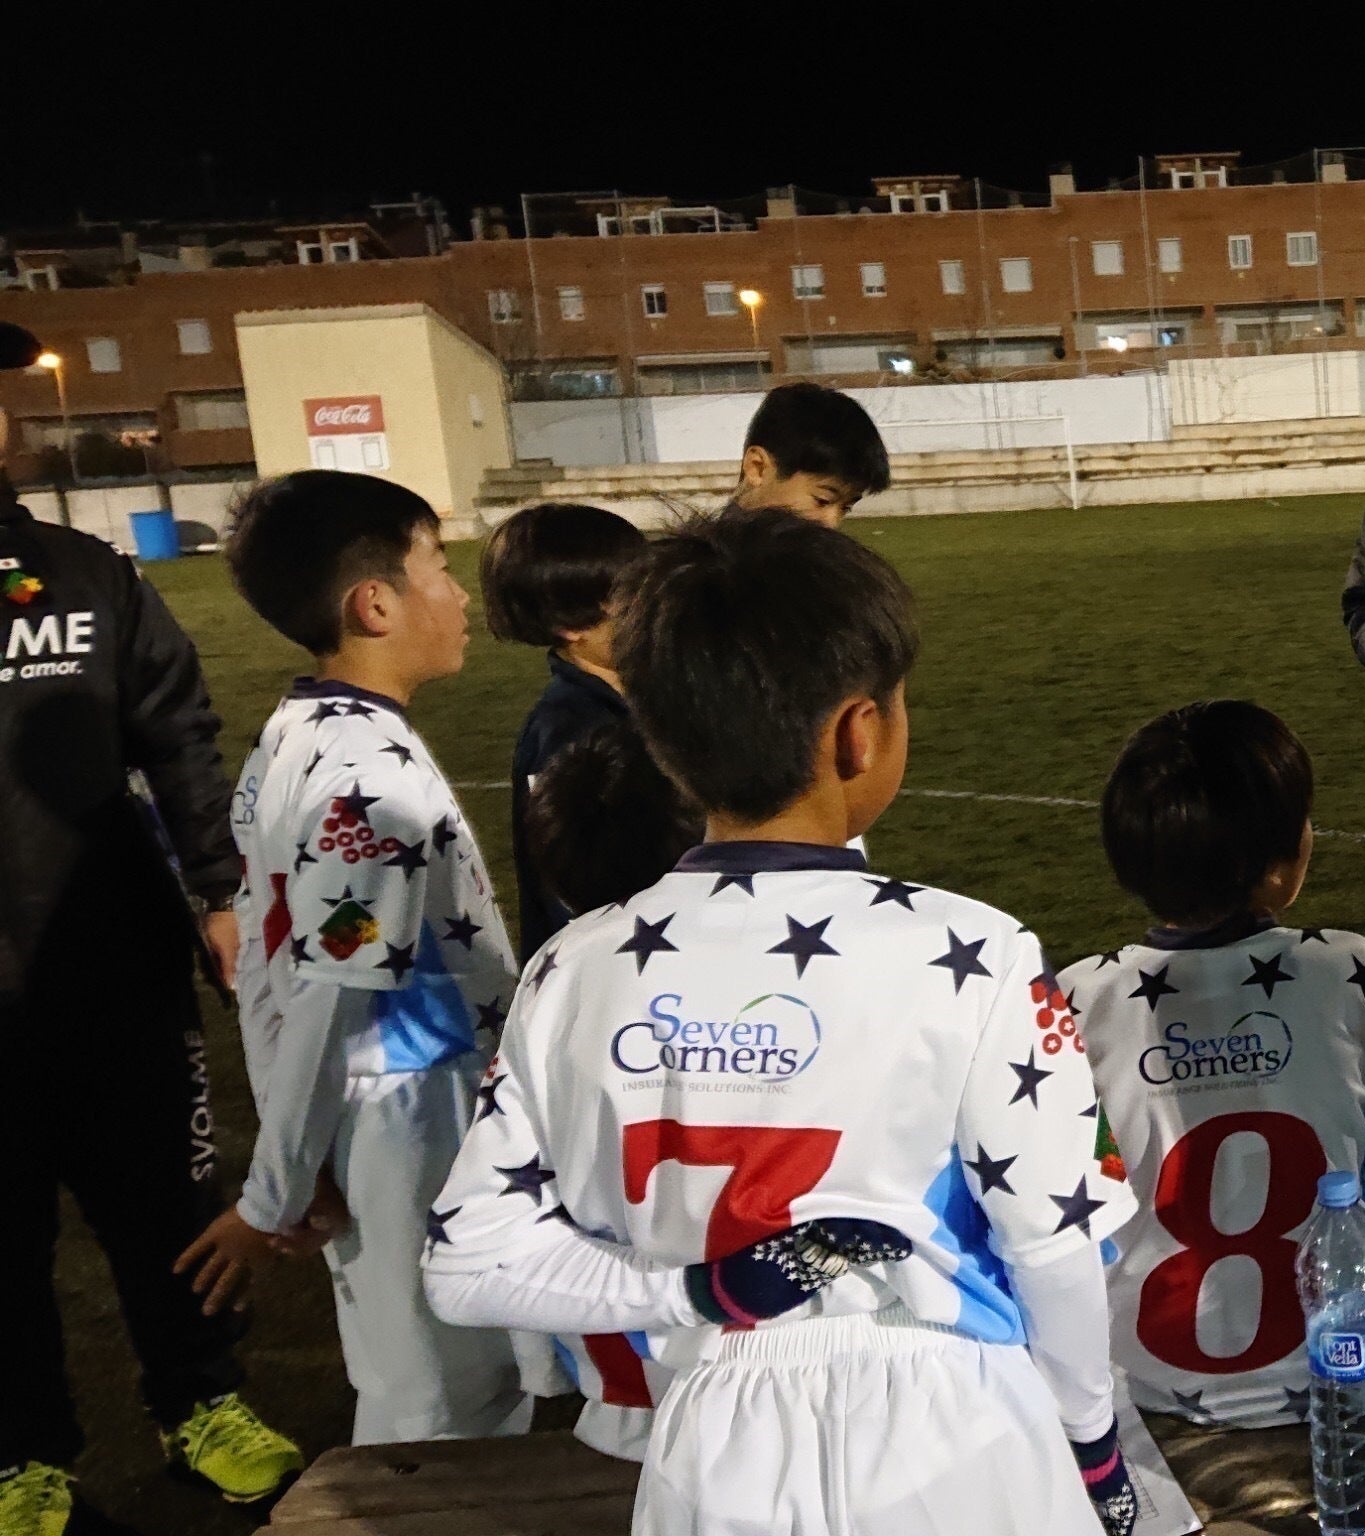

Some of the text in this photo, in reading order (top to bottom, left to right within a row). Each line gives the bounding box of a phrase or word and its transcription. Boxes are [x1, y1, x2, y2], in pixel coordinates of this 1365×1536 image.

[20, 660, 84, 679] amor.
[648, 993, 779, 1046] Seven
[1165, 1022, 1264, 1060] Seven
[610, 1022, 798, 1075] Corners
[1138, 1046, 1281, 1085] Corners
[184, 1030, 217, 1182] SVOLME
[688, 1082, 763, 1094] SOLUTIONS
[622, 1118, 843, 1336] 7
[1136, 1111, 1327, 1374] 8
[1327, 1350, 1359, 1365] Vella
